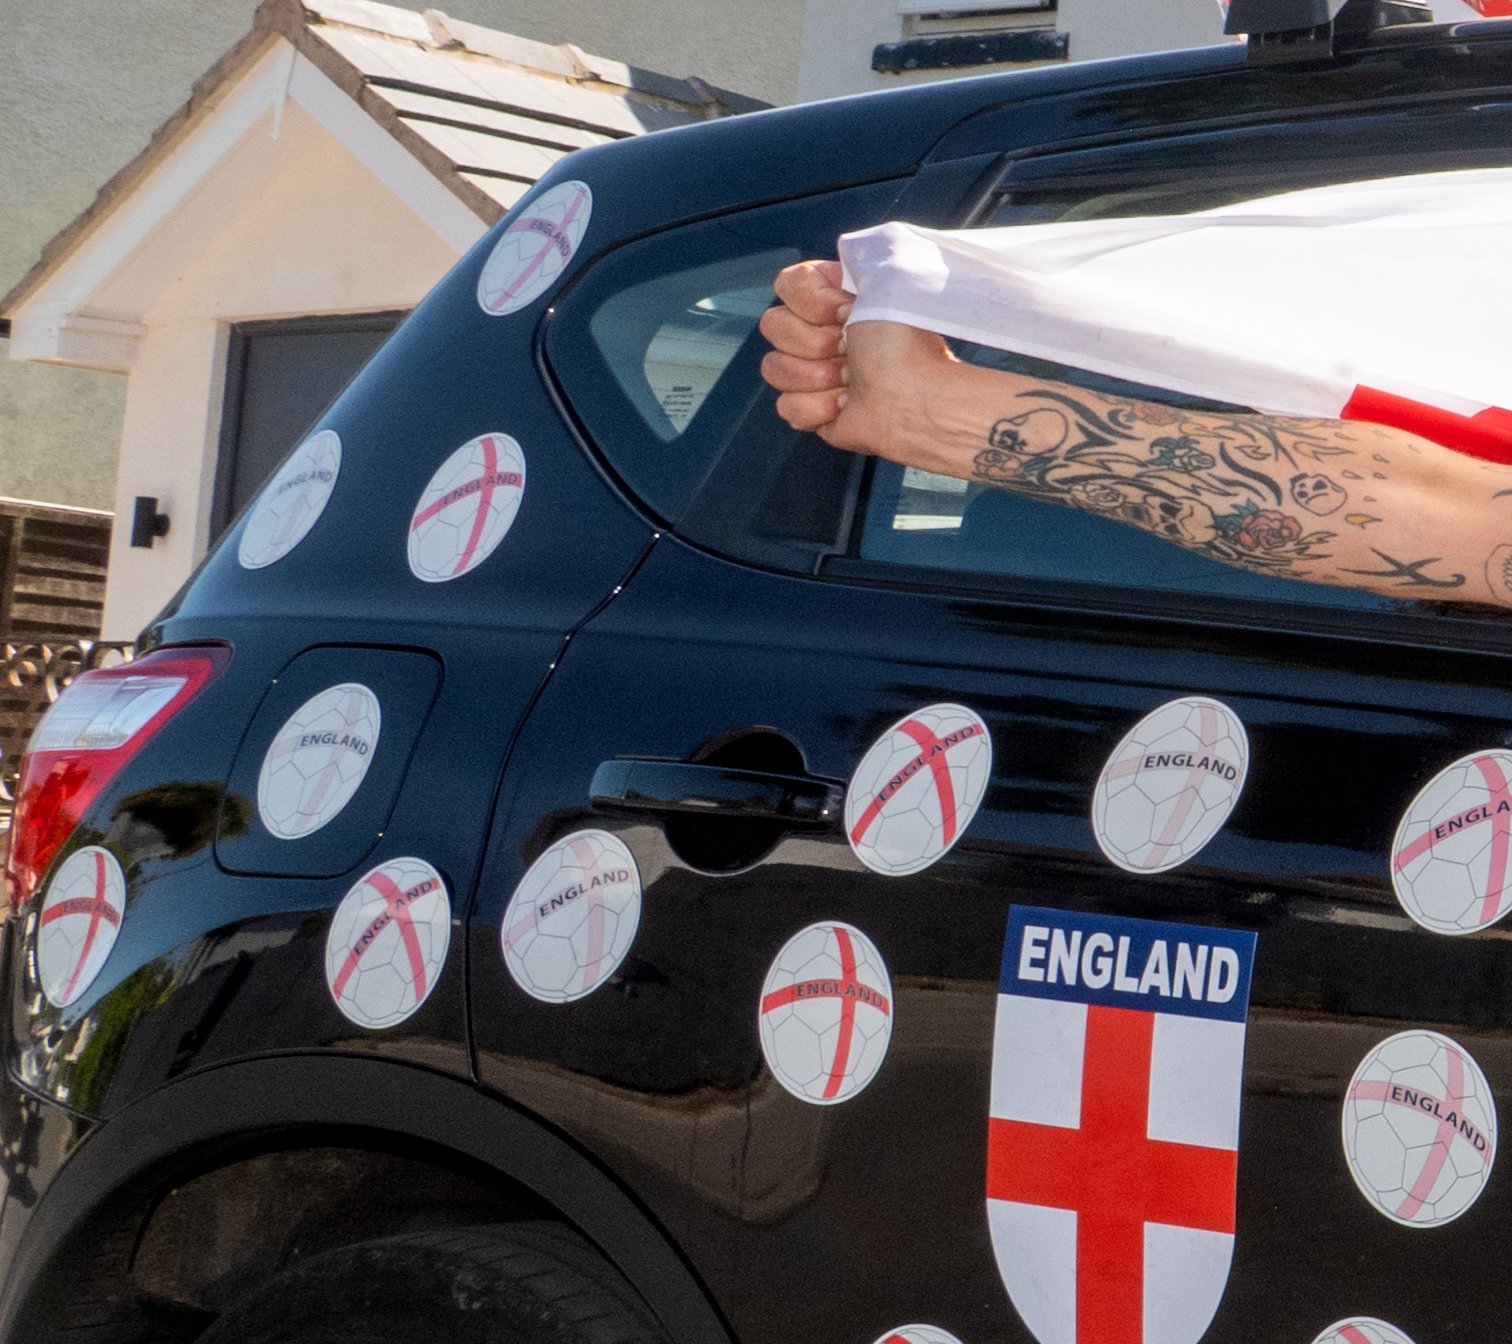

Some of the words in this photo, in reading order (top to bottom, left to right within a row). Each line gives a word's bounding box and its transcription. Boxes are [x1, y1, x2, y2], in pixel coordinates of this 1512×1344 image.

[530, 218, 570, 259] ENGLAND
[278, 470, 333, 495] ENGLAND
[443, 473, 517, 506] ENGLAND
[301, 731, 369, 756] ENGLAND
[879, 725, 974, 802] ENGLAND
[1144, 754, 1237, 781] ENGLAND
[539, 868, 631, 918] ENGLAND
[353, 881, 434, 956] ENGLAND
[1017, 924, 1240, 1004] ENGLAND
[795, 982, 884, 1009] ENGLAND
[1391, 1086, 1487, 1153] ENGLAND
